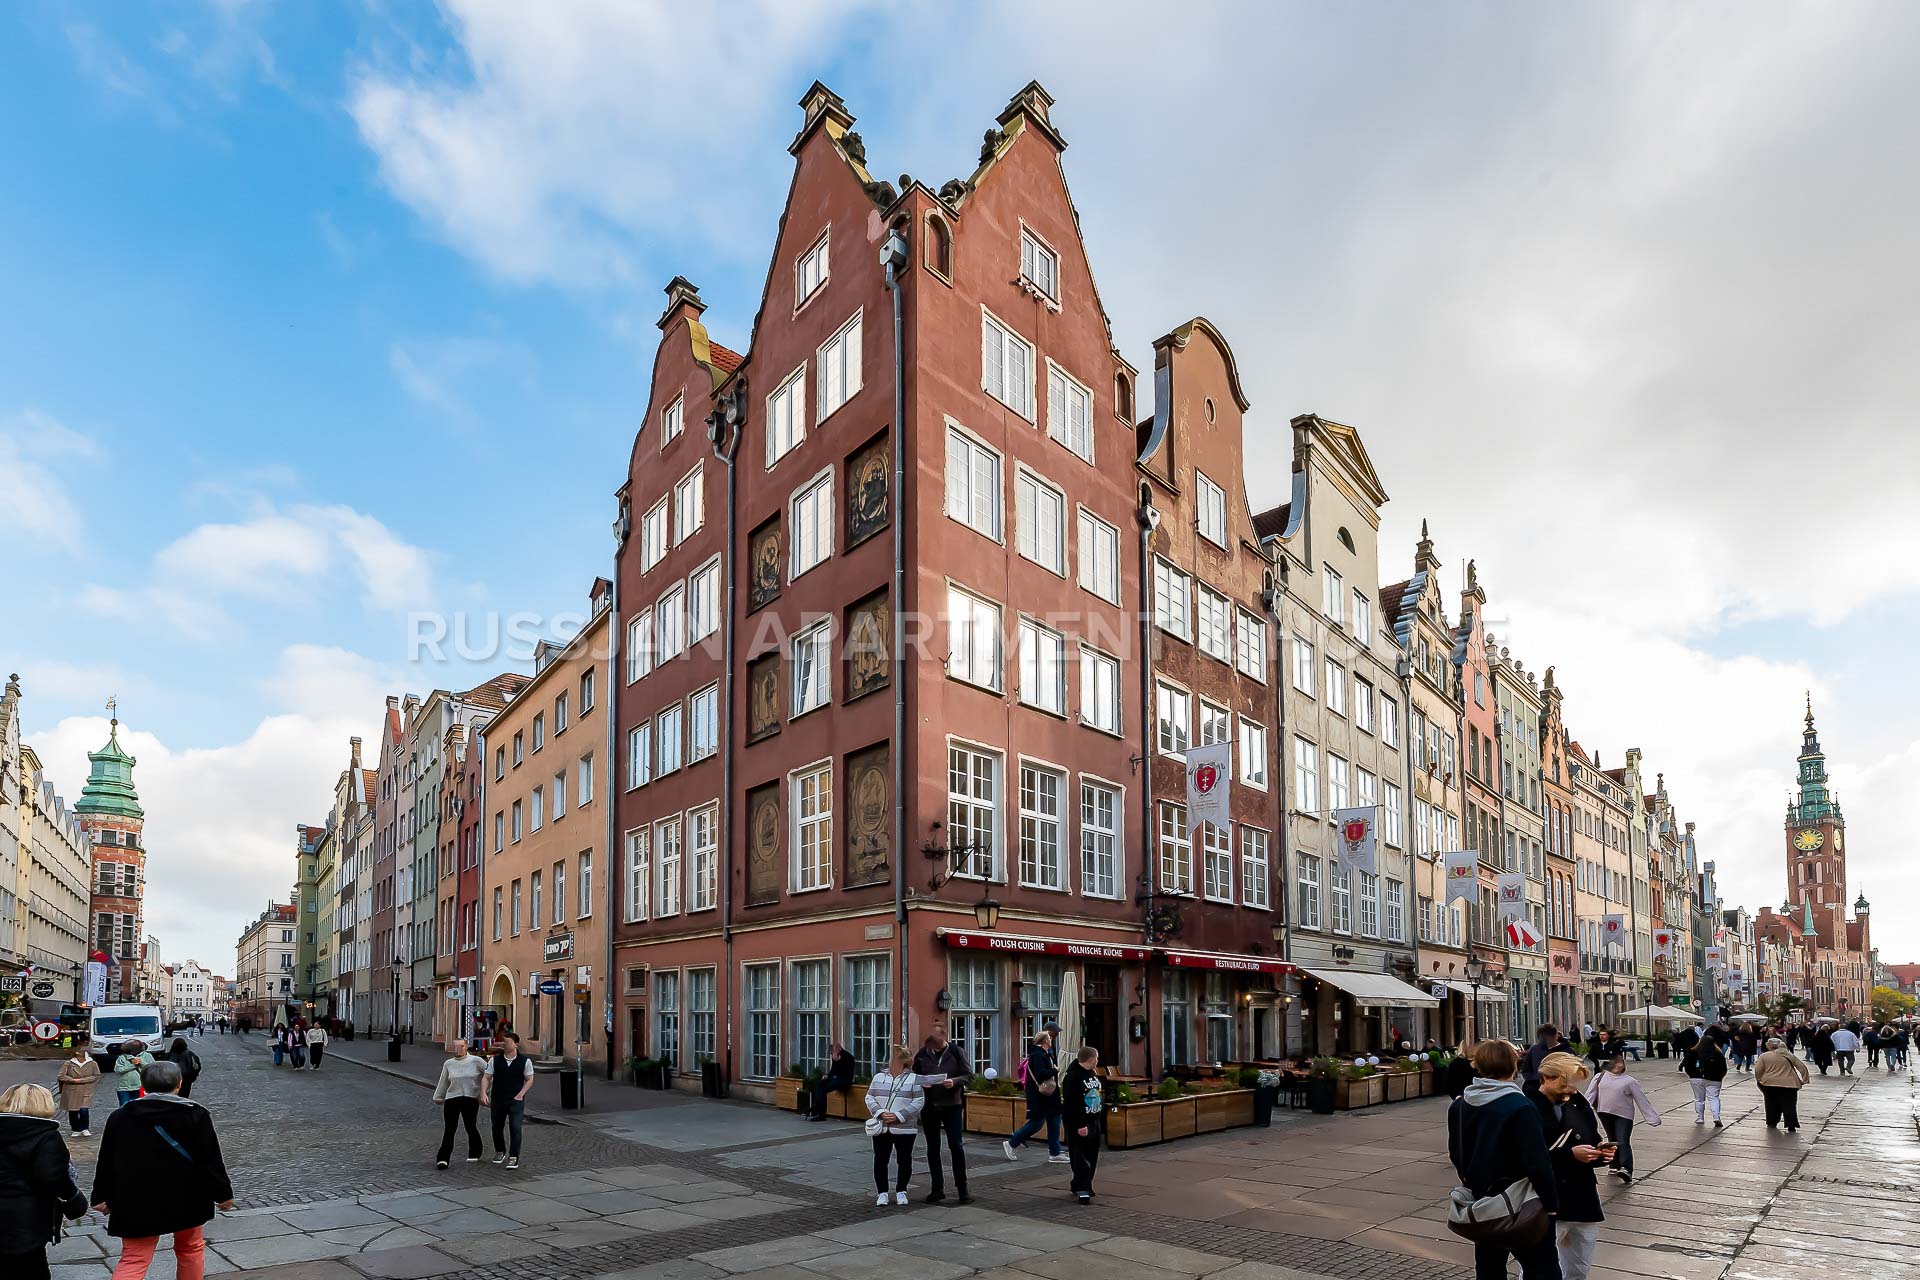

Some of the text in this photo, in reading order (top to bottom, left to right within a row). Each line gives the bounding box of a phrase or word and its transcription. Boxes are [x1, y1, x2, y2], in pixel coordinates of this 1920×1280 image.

[990, 938, 1045, 952] POLISH CUISINE
[1068, 945, 1123, 957] POLNISCHE KÜCHE
